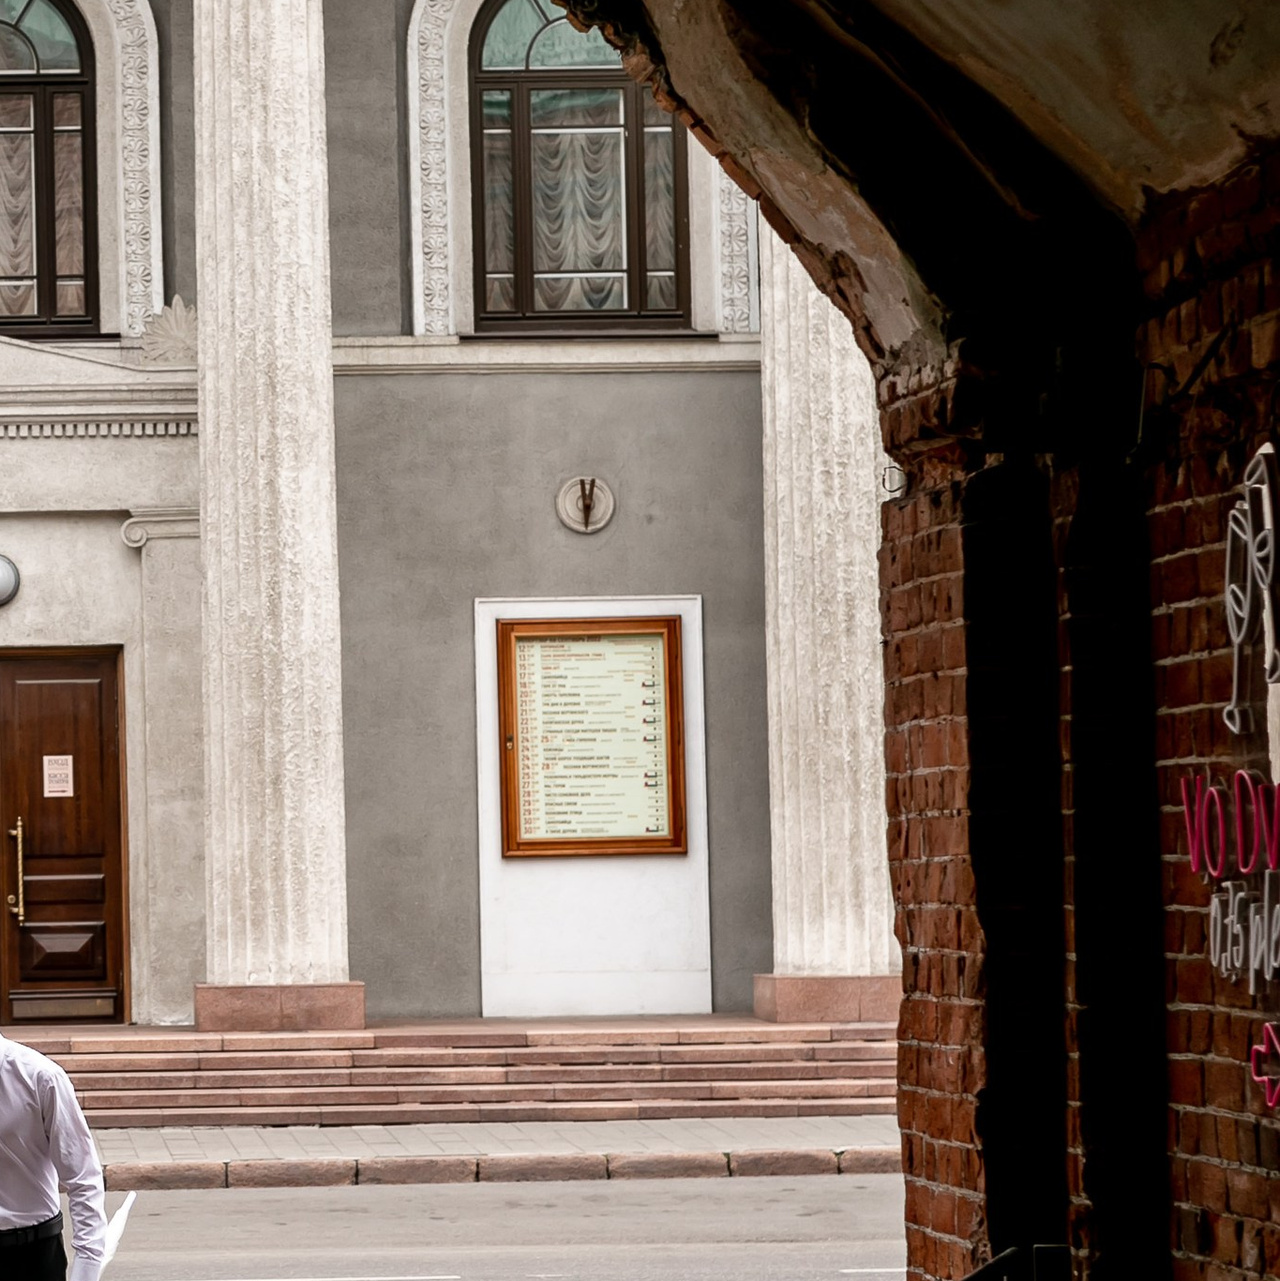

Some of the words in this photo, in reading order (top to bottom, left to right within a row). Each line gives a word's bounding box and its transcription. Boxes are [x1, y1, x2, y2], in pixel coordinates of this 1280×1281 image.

[523, 799, 531, 807] 29
[523, 808, 531, 816] 29
[1181, 774, 1226, 879] VO
